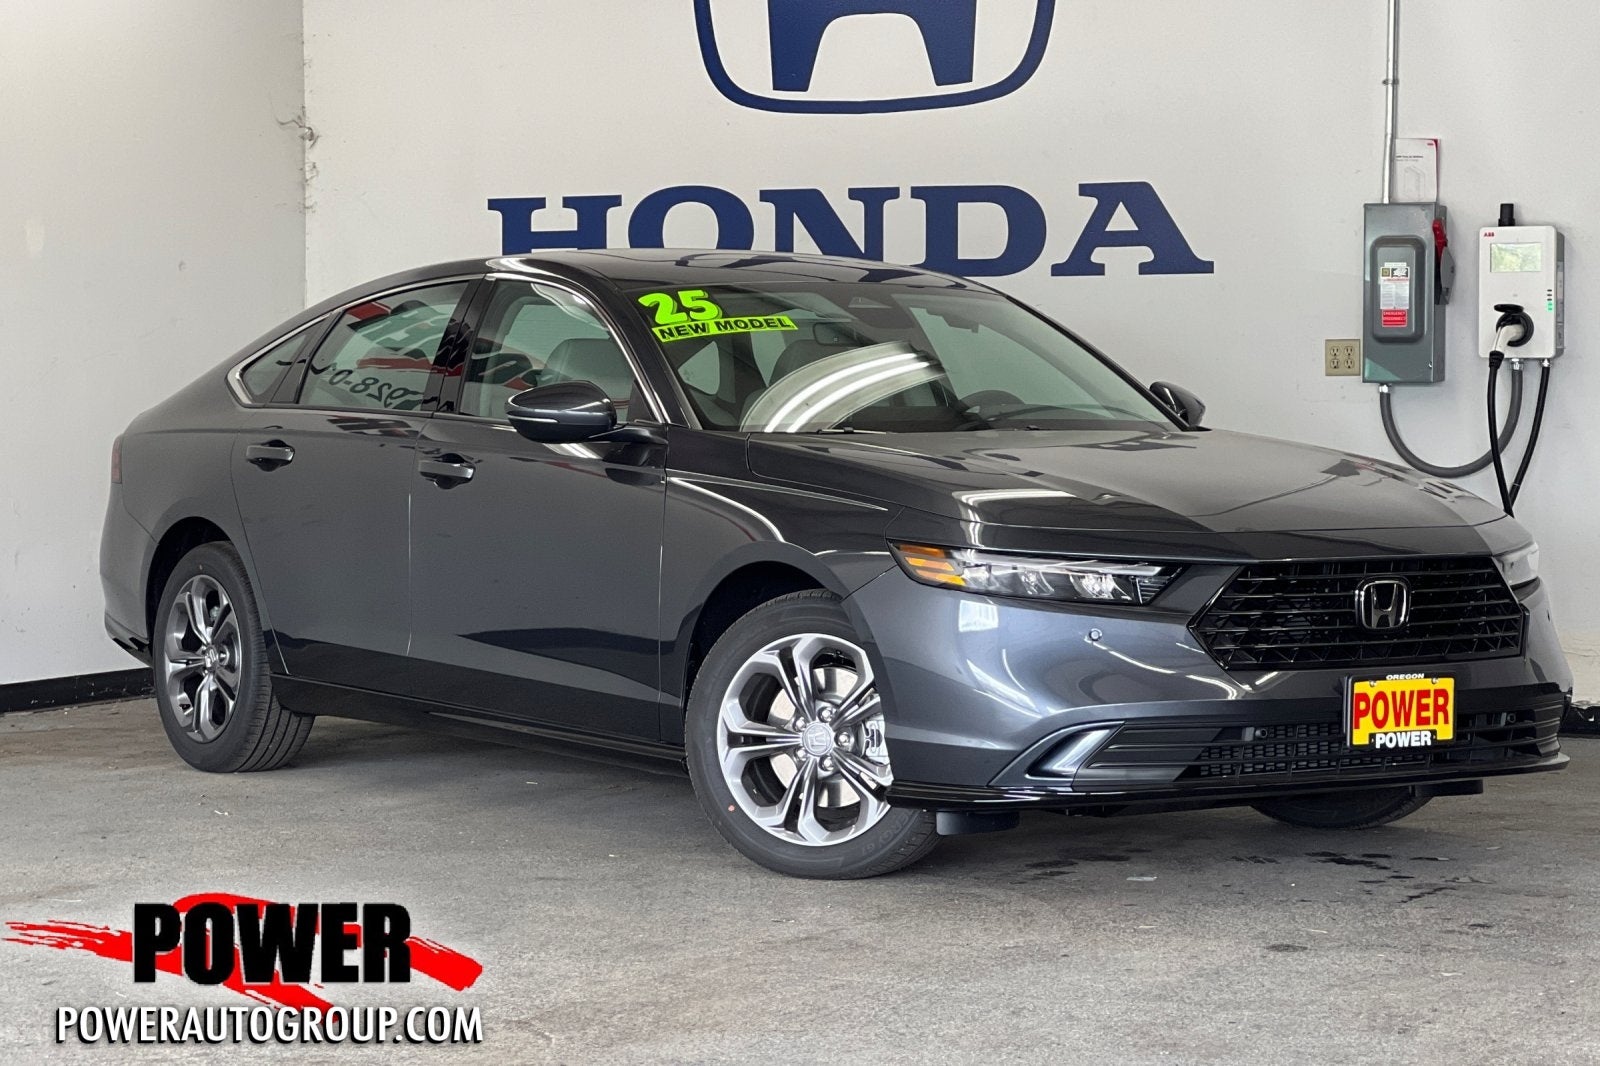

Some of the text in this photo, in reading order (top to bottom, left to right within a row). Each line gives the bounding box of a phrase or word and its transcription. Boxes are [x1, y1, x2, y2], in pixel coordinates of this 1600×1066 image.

[487, 181, 1215, 279] HONDA
[638, 290, 721, 324] 25
[658, 317, 791, 340] NEW MODEL
[1386, 673, 1425, 681] OREGON
[1353, 688, 1449, 729] POWER
[1375, 730, 1432, 749] POWER
